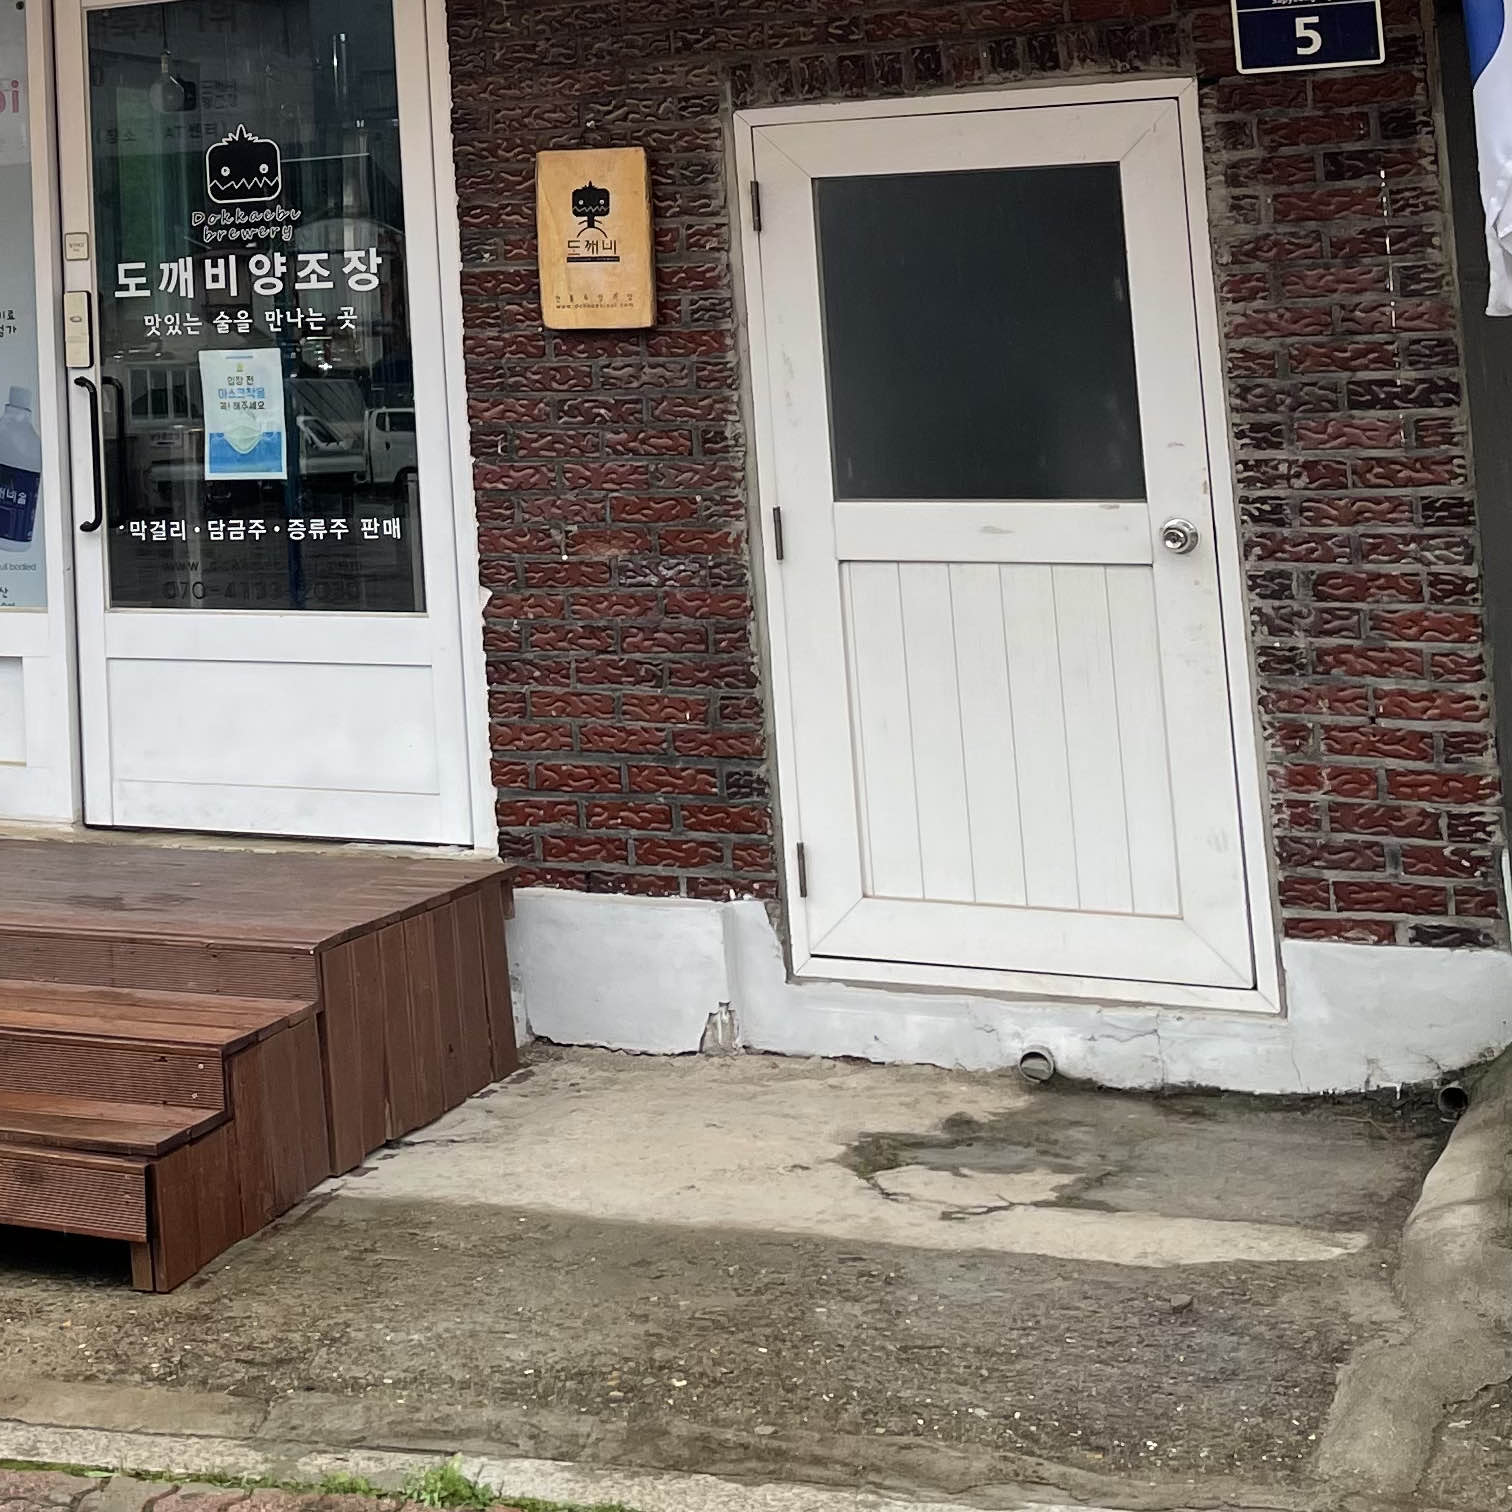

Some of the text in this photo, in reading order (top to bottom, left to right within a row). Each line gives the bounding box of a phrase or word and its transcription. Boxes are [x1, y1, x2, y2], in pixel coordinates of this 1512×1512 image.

[1295, 15, 1322, 55] 5
[191, 204, 302, 226] Dokkaebi
[203, 225, 293, 243] brewery
[114, 247, 383, 299] 도깨비양조장
[143, 306, 358, 338] 맛있는 술을 만나는 곳
[360, 517, 402, 540] 판매
